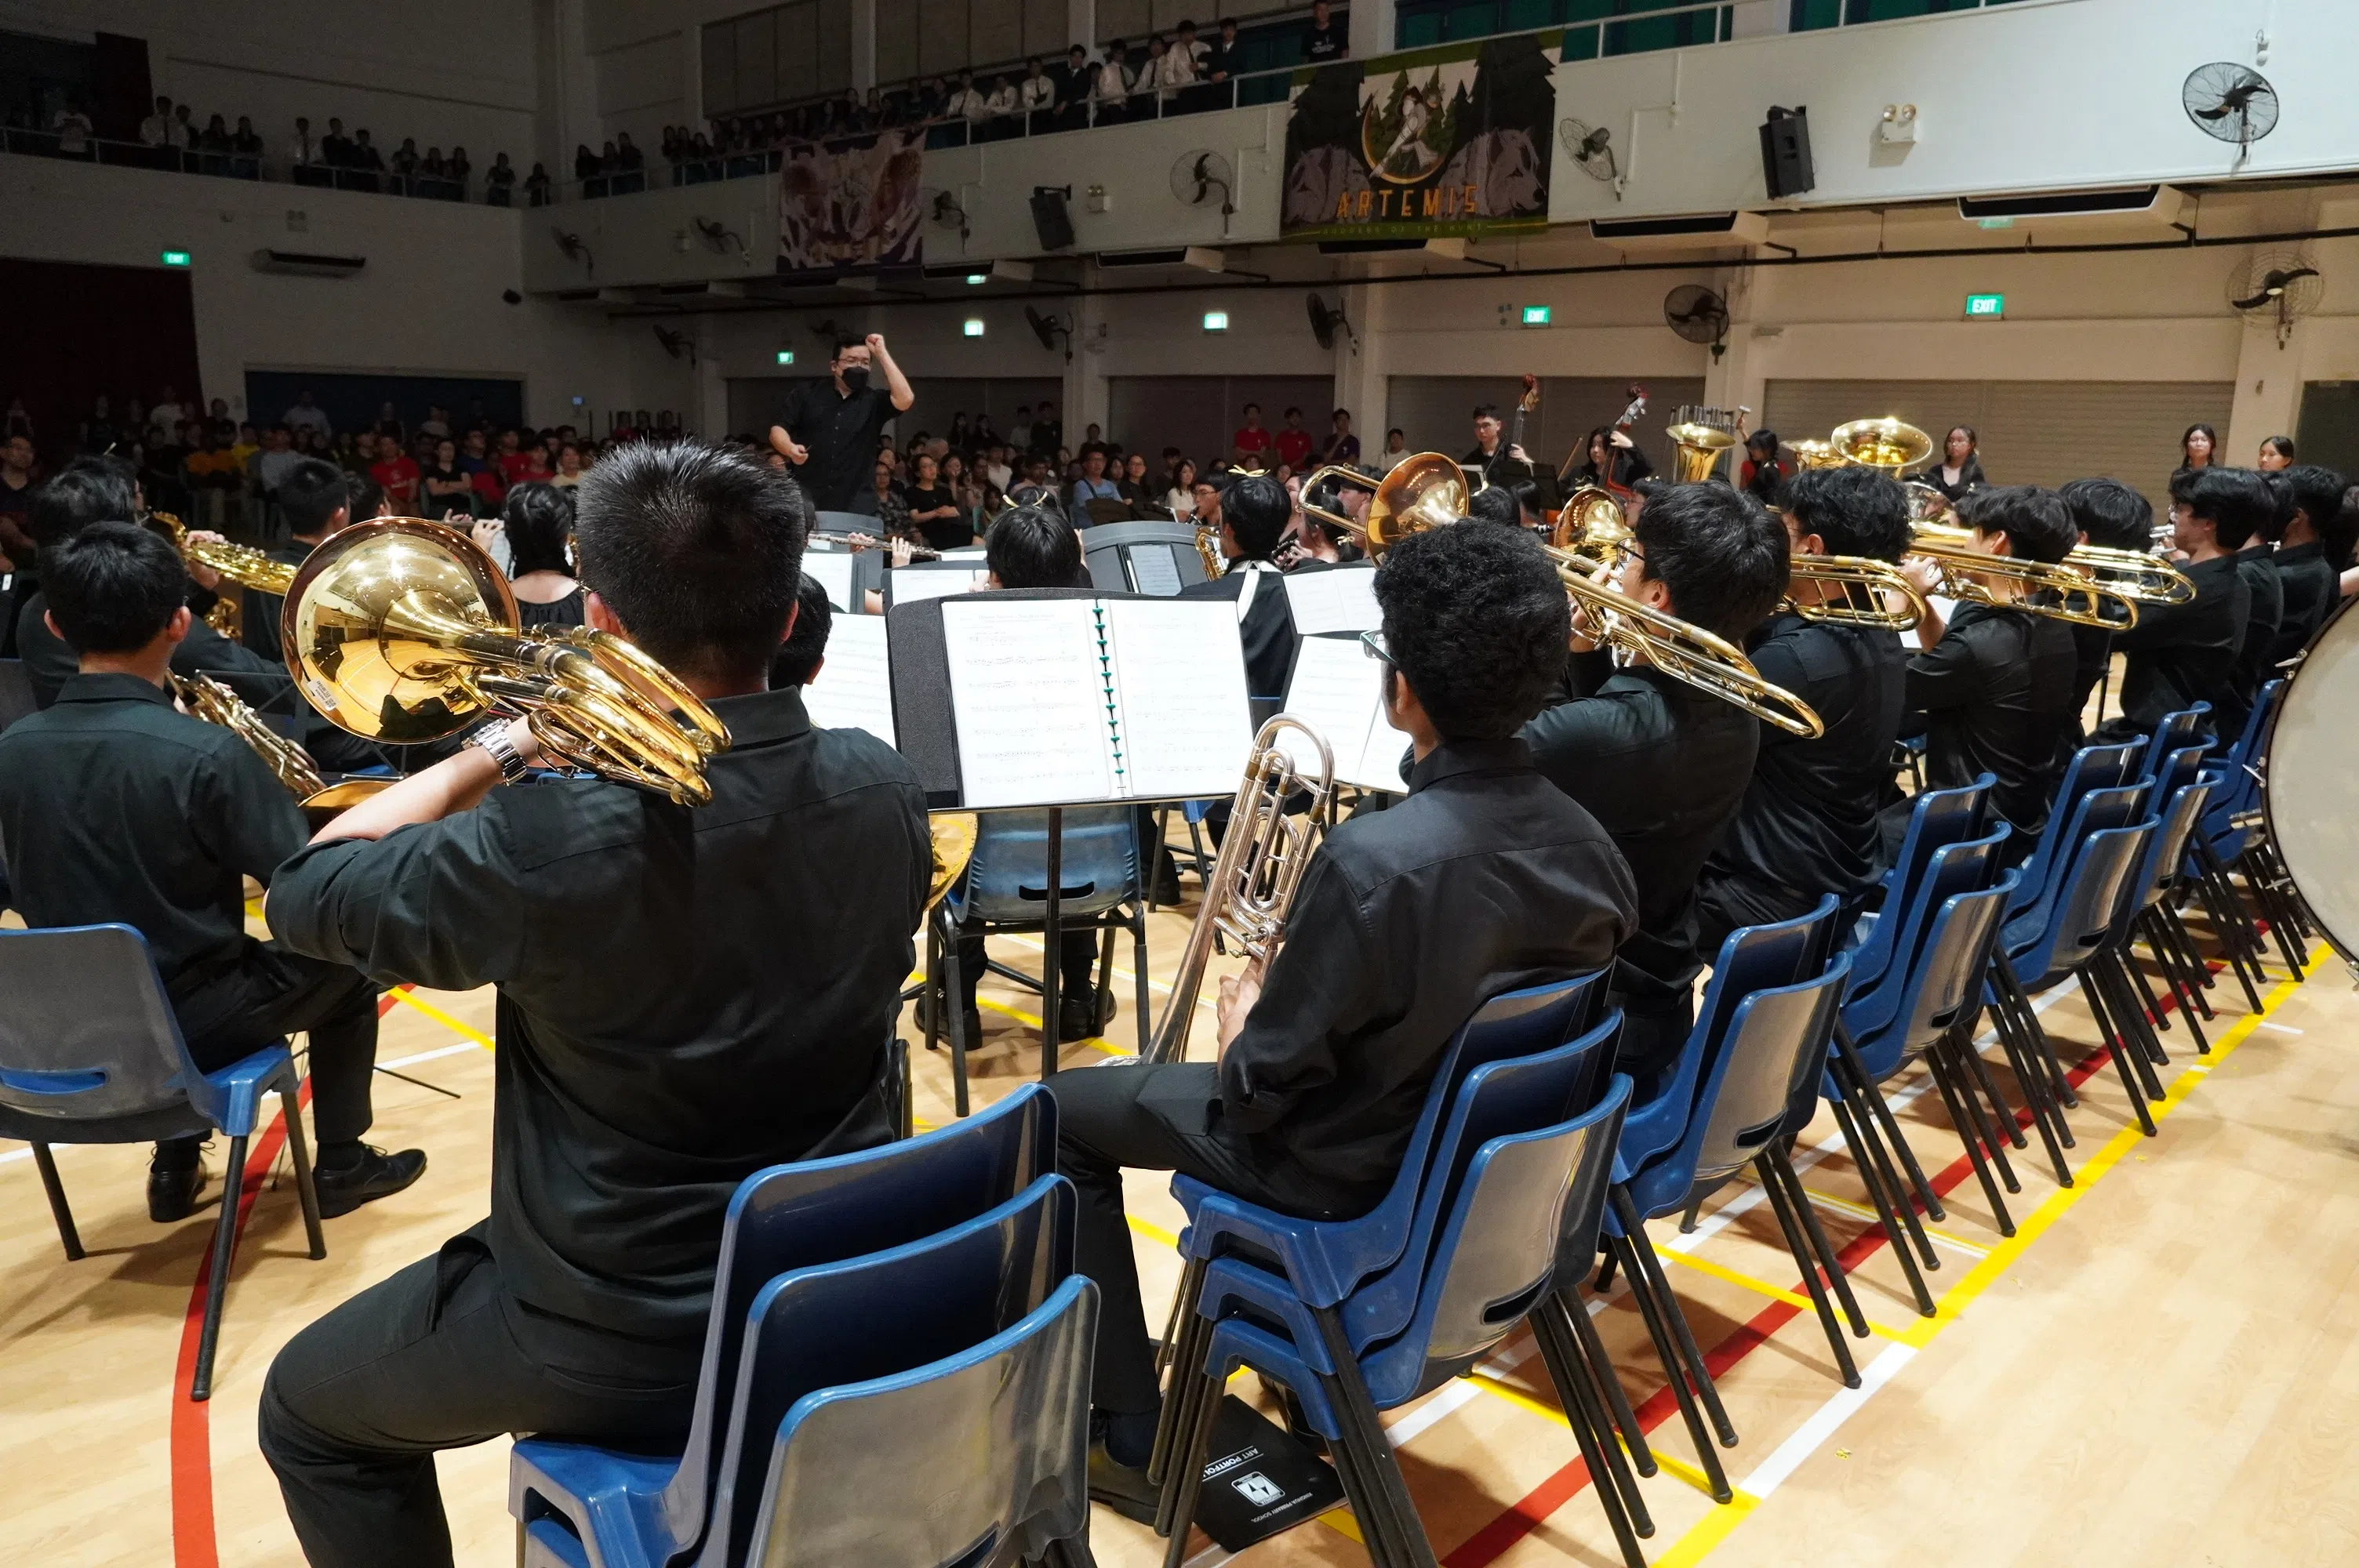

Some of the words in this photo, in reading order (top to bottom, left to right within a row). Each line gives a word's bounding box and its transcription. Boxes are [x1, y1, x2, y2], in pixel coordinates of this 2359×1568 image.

[1336, 184, 1478, 219] ARTEMIS
[1972, 299, 1997, 313] EXIT
[1527, 310, 1545, 322] EXIT
[1242, 1448, 1259, 1458] ART
[1291, 1492, 1314, 1504] XINGHUA
[1271, 1501, 1292, 1514] PRIMARY
[1252, 1511, 1271, 1523] SCHOOL
